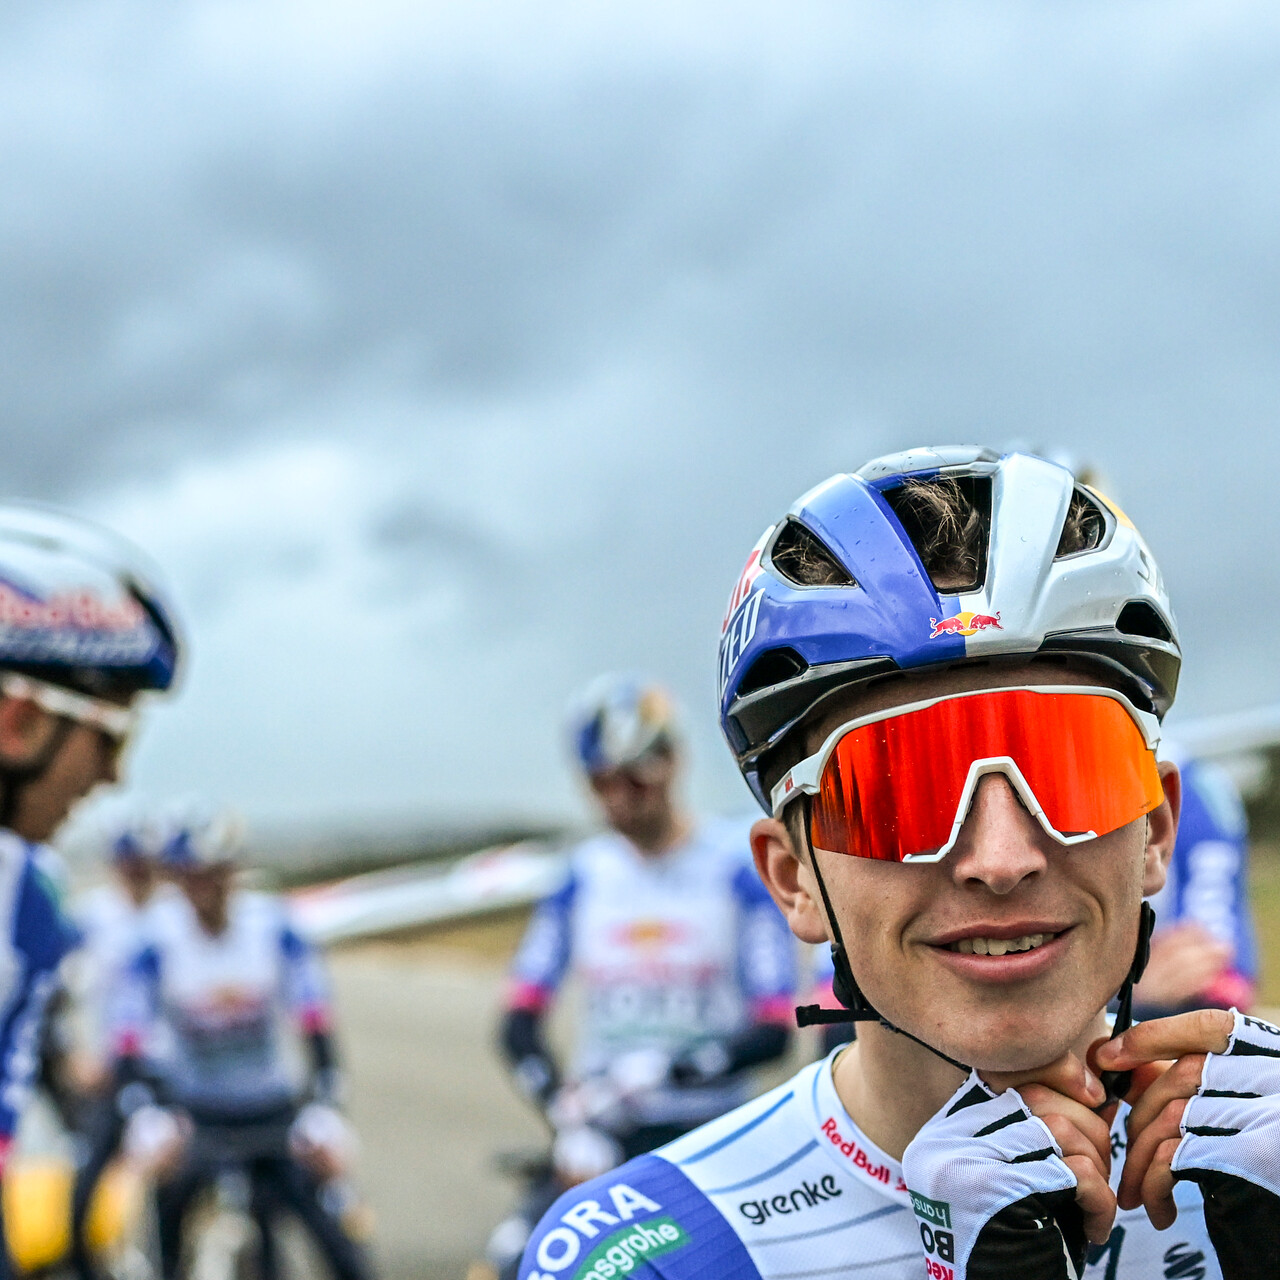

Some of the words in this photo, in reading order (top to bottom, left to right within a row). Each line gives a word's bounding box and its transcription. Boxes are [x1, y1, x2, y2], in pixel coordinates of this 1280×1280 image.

[821, 1116, 855, 1158] Red
[852, 1147, 890, 1184] Bull
[740, 1174, 843, 1225] grenke
